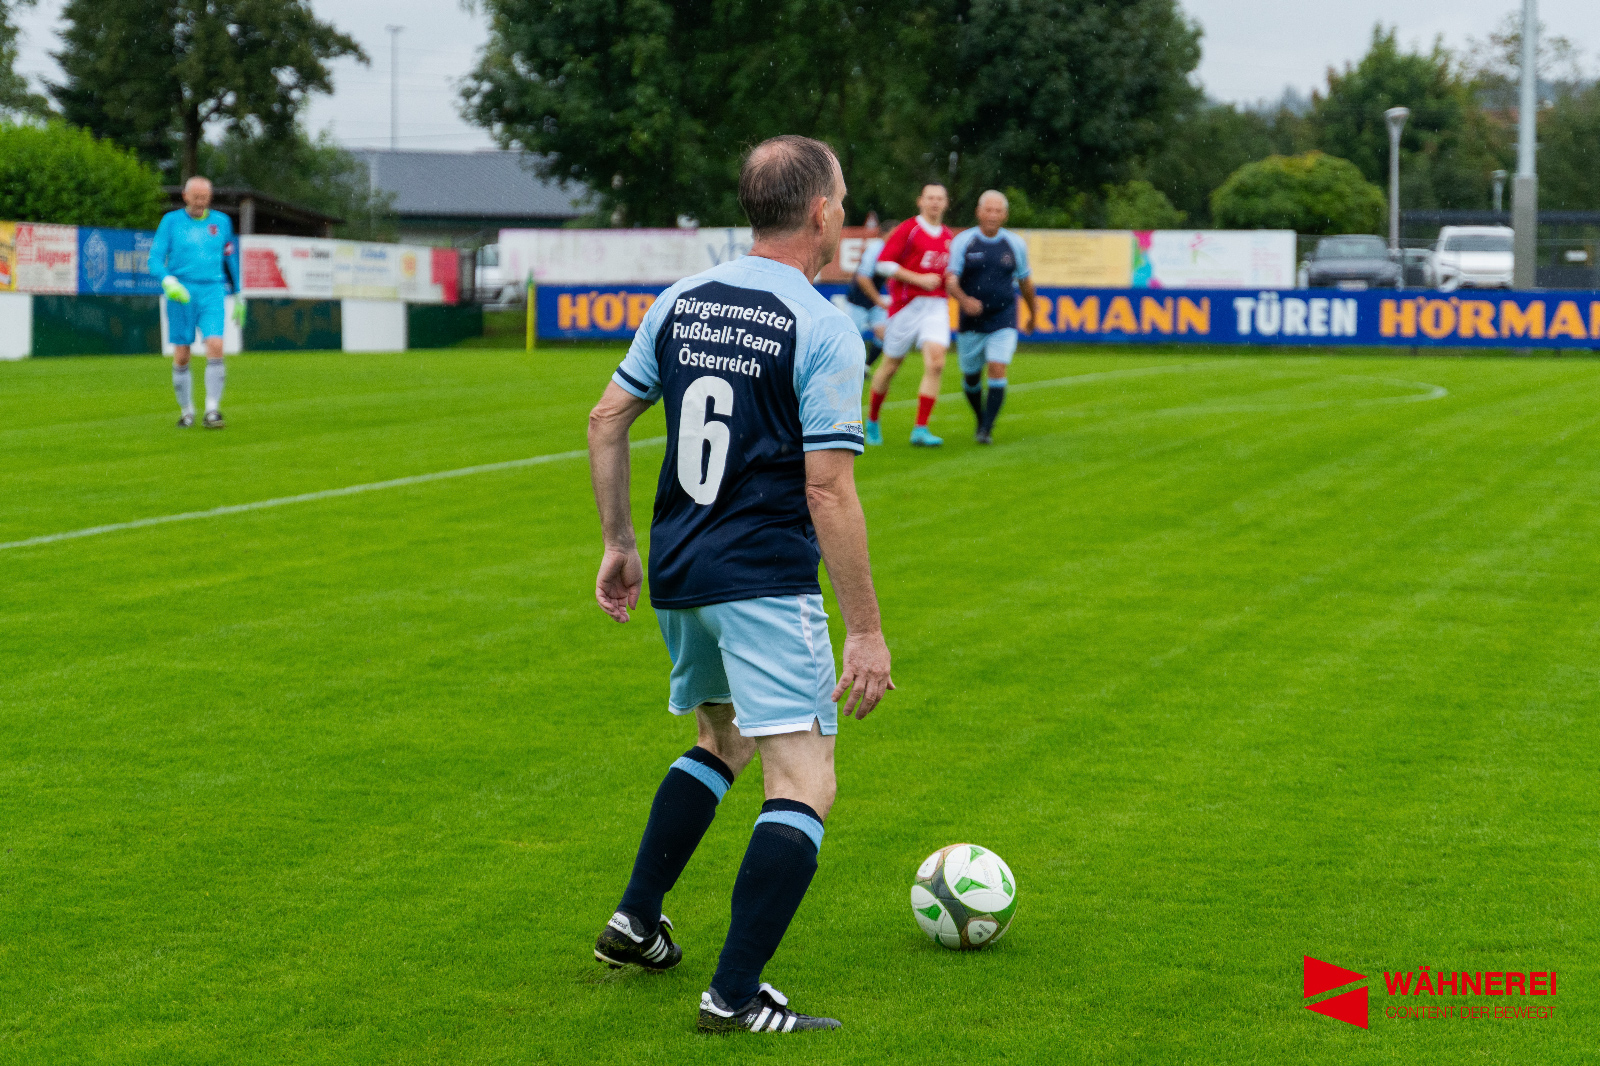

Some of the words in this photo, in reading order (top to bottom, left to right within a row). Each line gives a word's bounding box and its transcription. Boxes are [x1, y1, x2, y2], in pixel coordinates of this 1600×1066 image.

[557, 291, 658, 331] HÖR
[674, 297, 794, 332] Bürgermeister
[1016, 295, 1211, 335] RMANN
[1233, 291, 1357, 336] TÜREN
[672, 321, 782, 357] Fußball-Team
[678, 342, 761, 378] Österreich
[677, 375, 733, 506] 6
